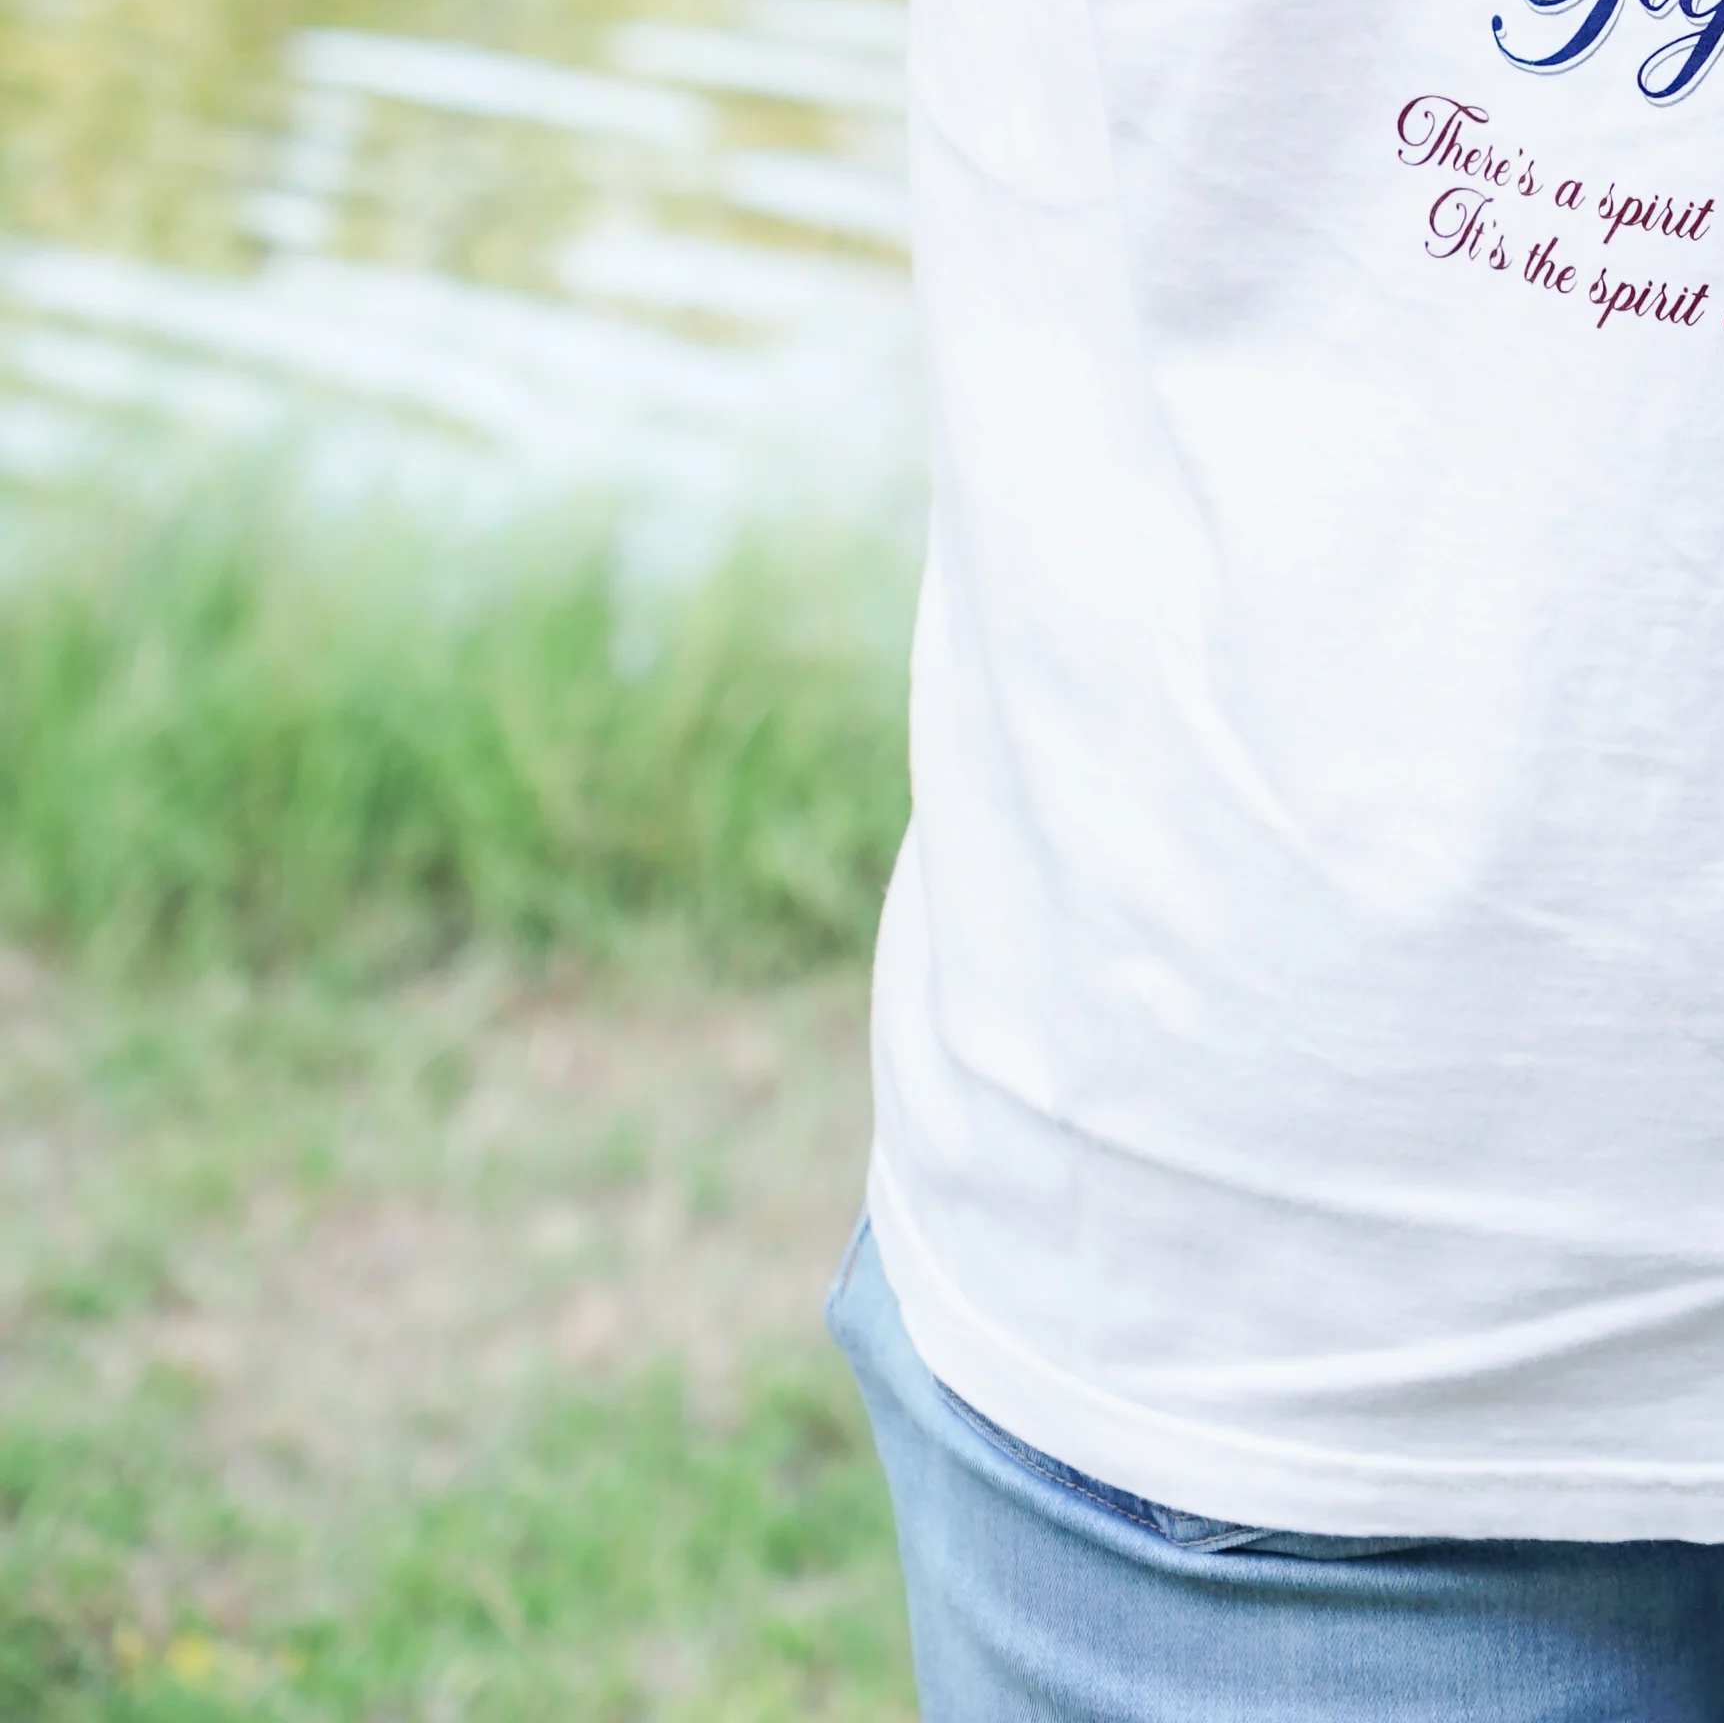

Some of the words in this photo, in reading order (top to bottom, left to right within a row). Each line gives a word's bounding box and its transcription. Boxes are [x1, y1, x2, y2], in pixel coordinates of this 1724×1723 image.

[1396, 94, 1544, 197] There's
[1554, 179, 1586, 210] a
[1597, 181, 1716, 245] spirit
[1424, 186, 1513, 271] It's
[1523, 236, 1578, 294] the
[1588, 267, 1710, 330] spirit
